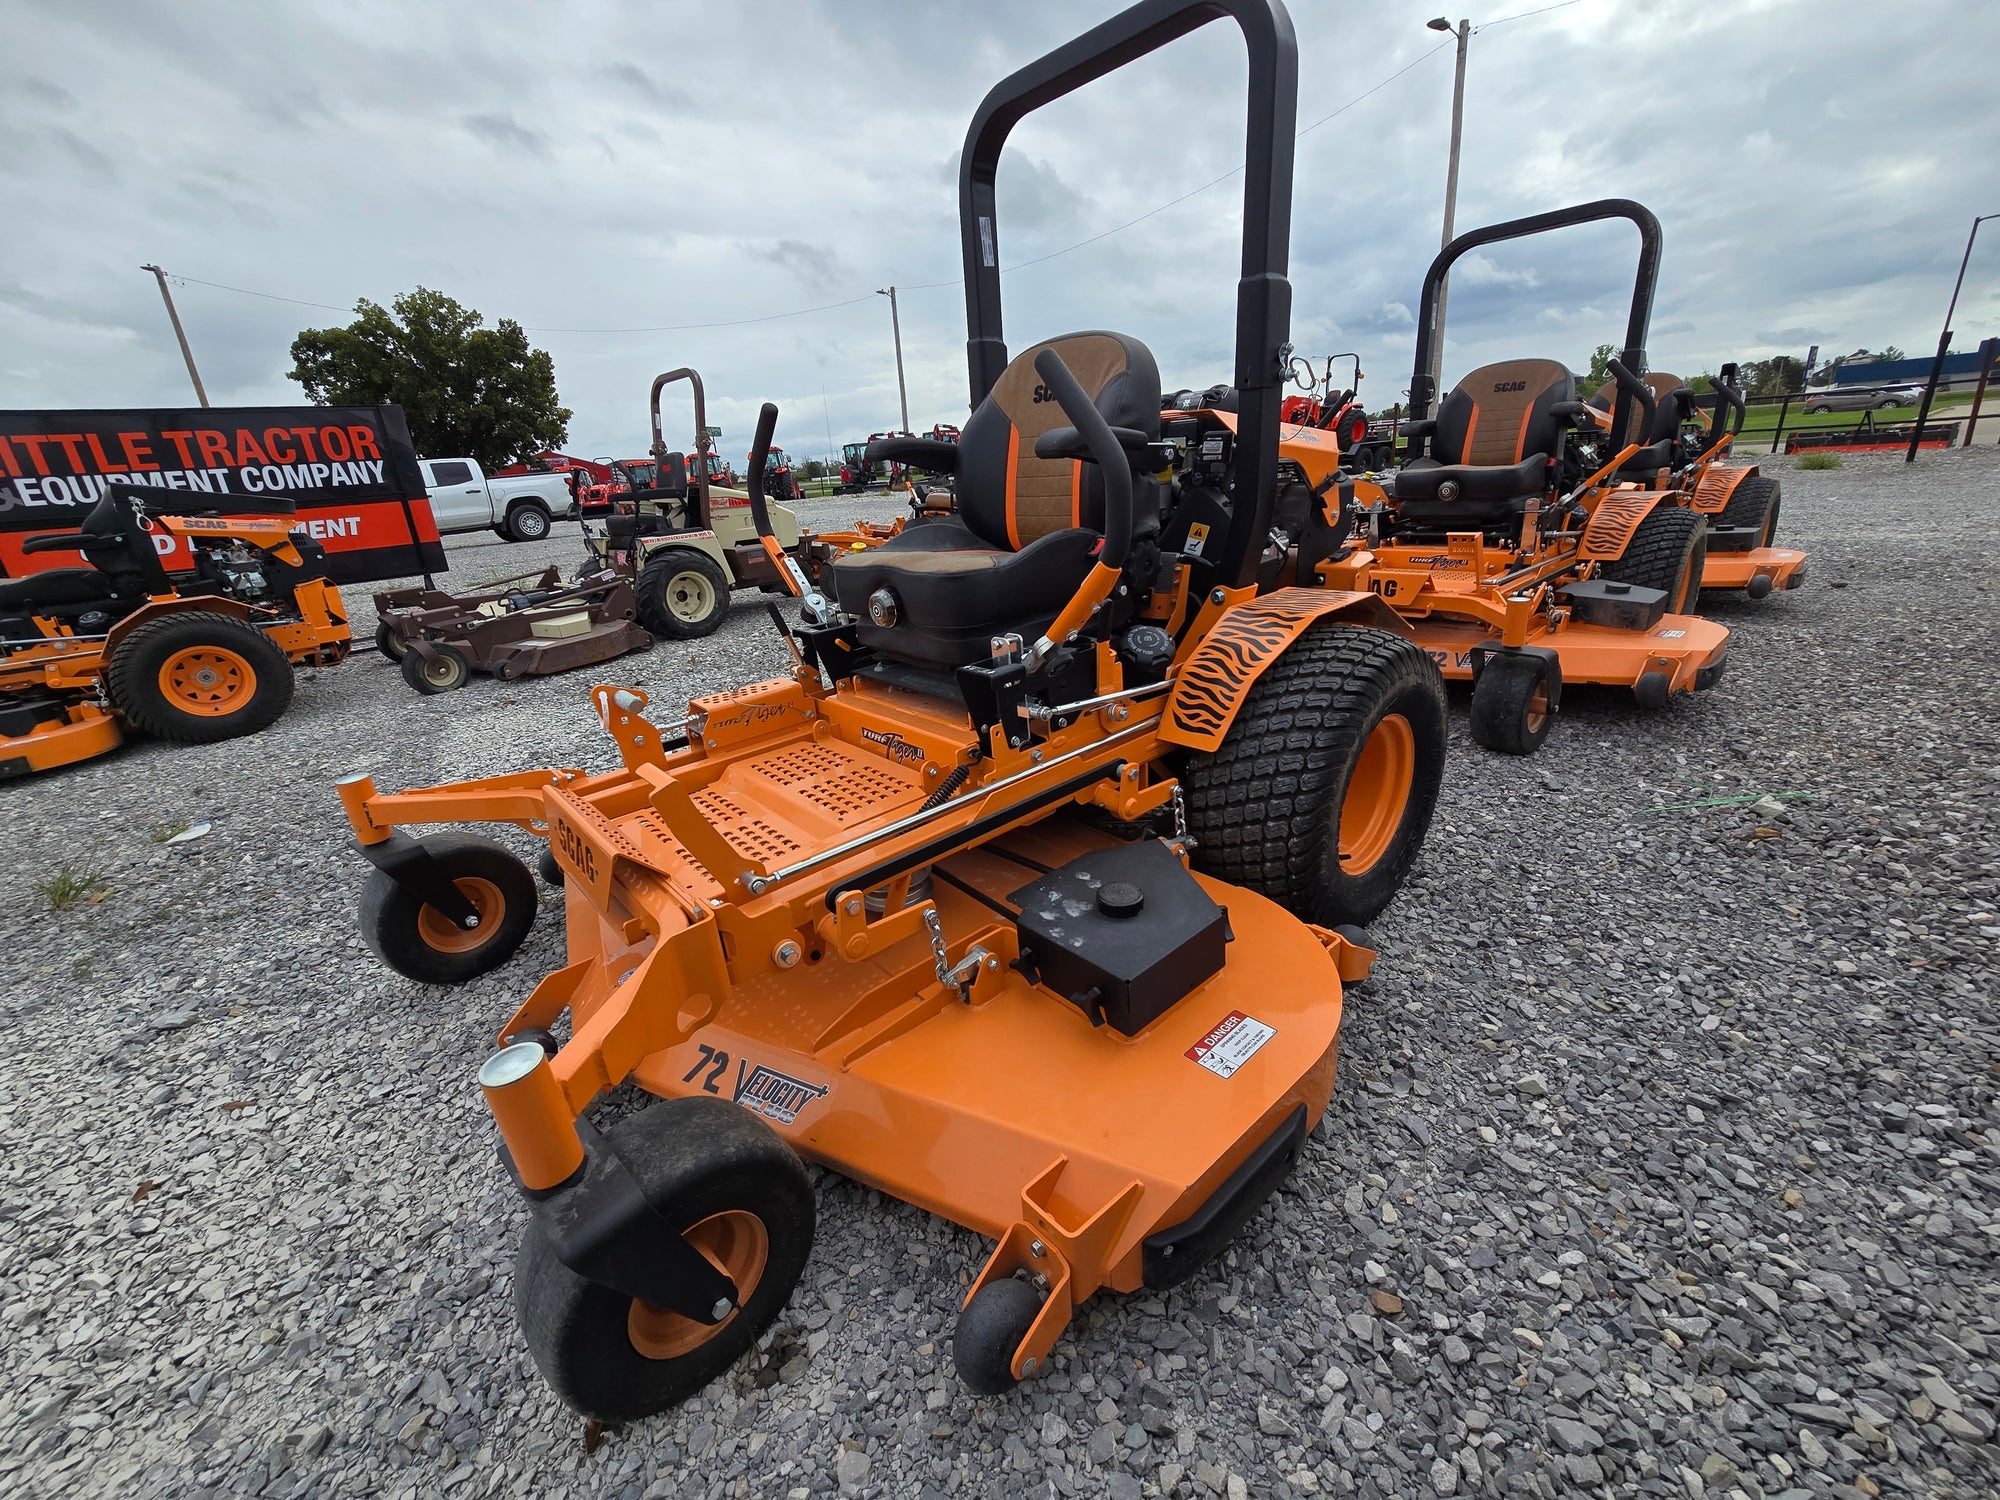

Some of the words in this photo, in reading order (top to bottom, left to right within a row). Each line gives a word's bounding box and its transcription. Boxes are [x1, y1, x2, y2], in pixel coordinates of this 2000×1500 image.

[1033, 385, 1057, 403] SC
[1493, 381, 1526, 392] SCAG
[0, 432, 160, 477] ITTLE
[161, 425, 382, 469] TRACTOR
[240, 460, 384, 493] COMPANY
[183, 520, 228, 529] SCAG
[1371, 579, 1398, 598] AG
[862, 728, 888, 745] TURF
[881, 732, 918, 765] Tiger
[558, 818, 595, 883] SCAG
[1204, 1016, 1241, 1046] DANGER
[682, 1044, 730, 1095] 72
[733, 1058, 818, 1114] VELOCITY
[737, 1093, 796, 1124] PLUS
